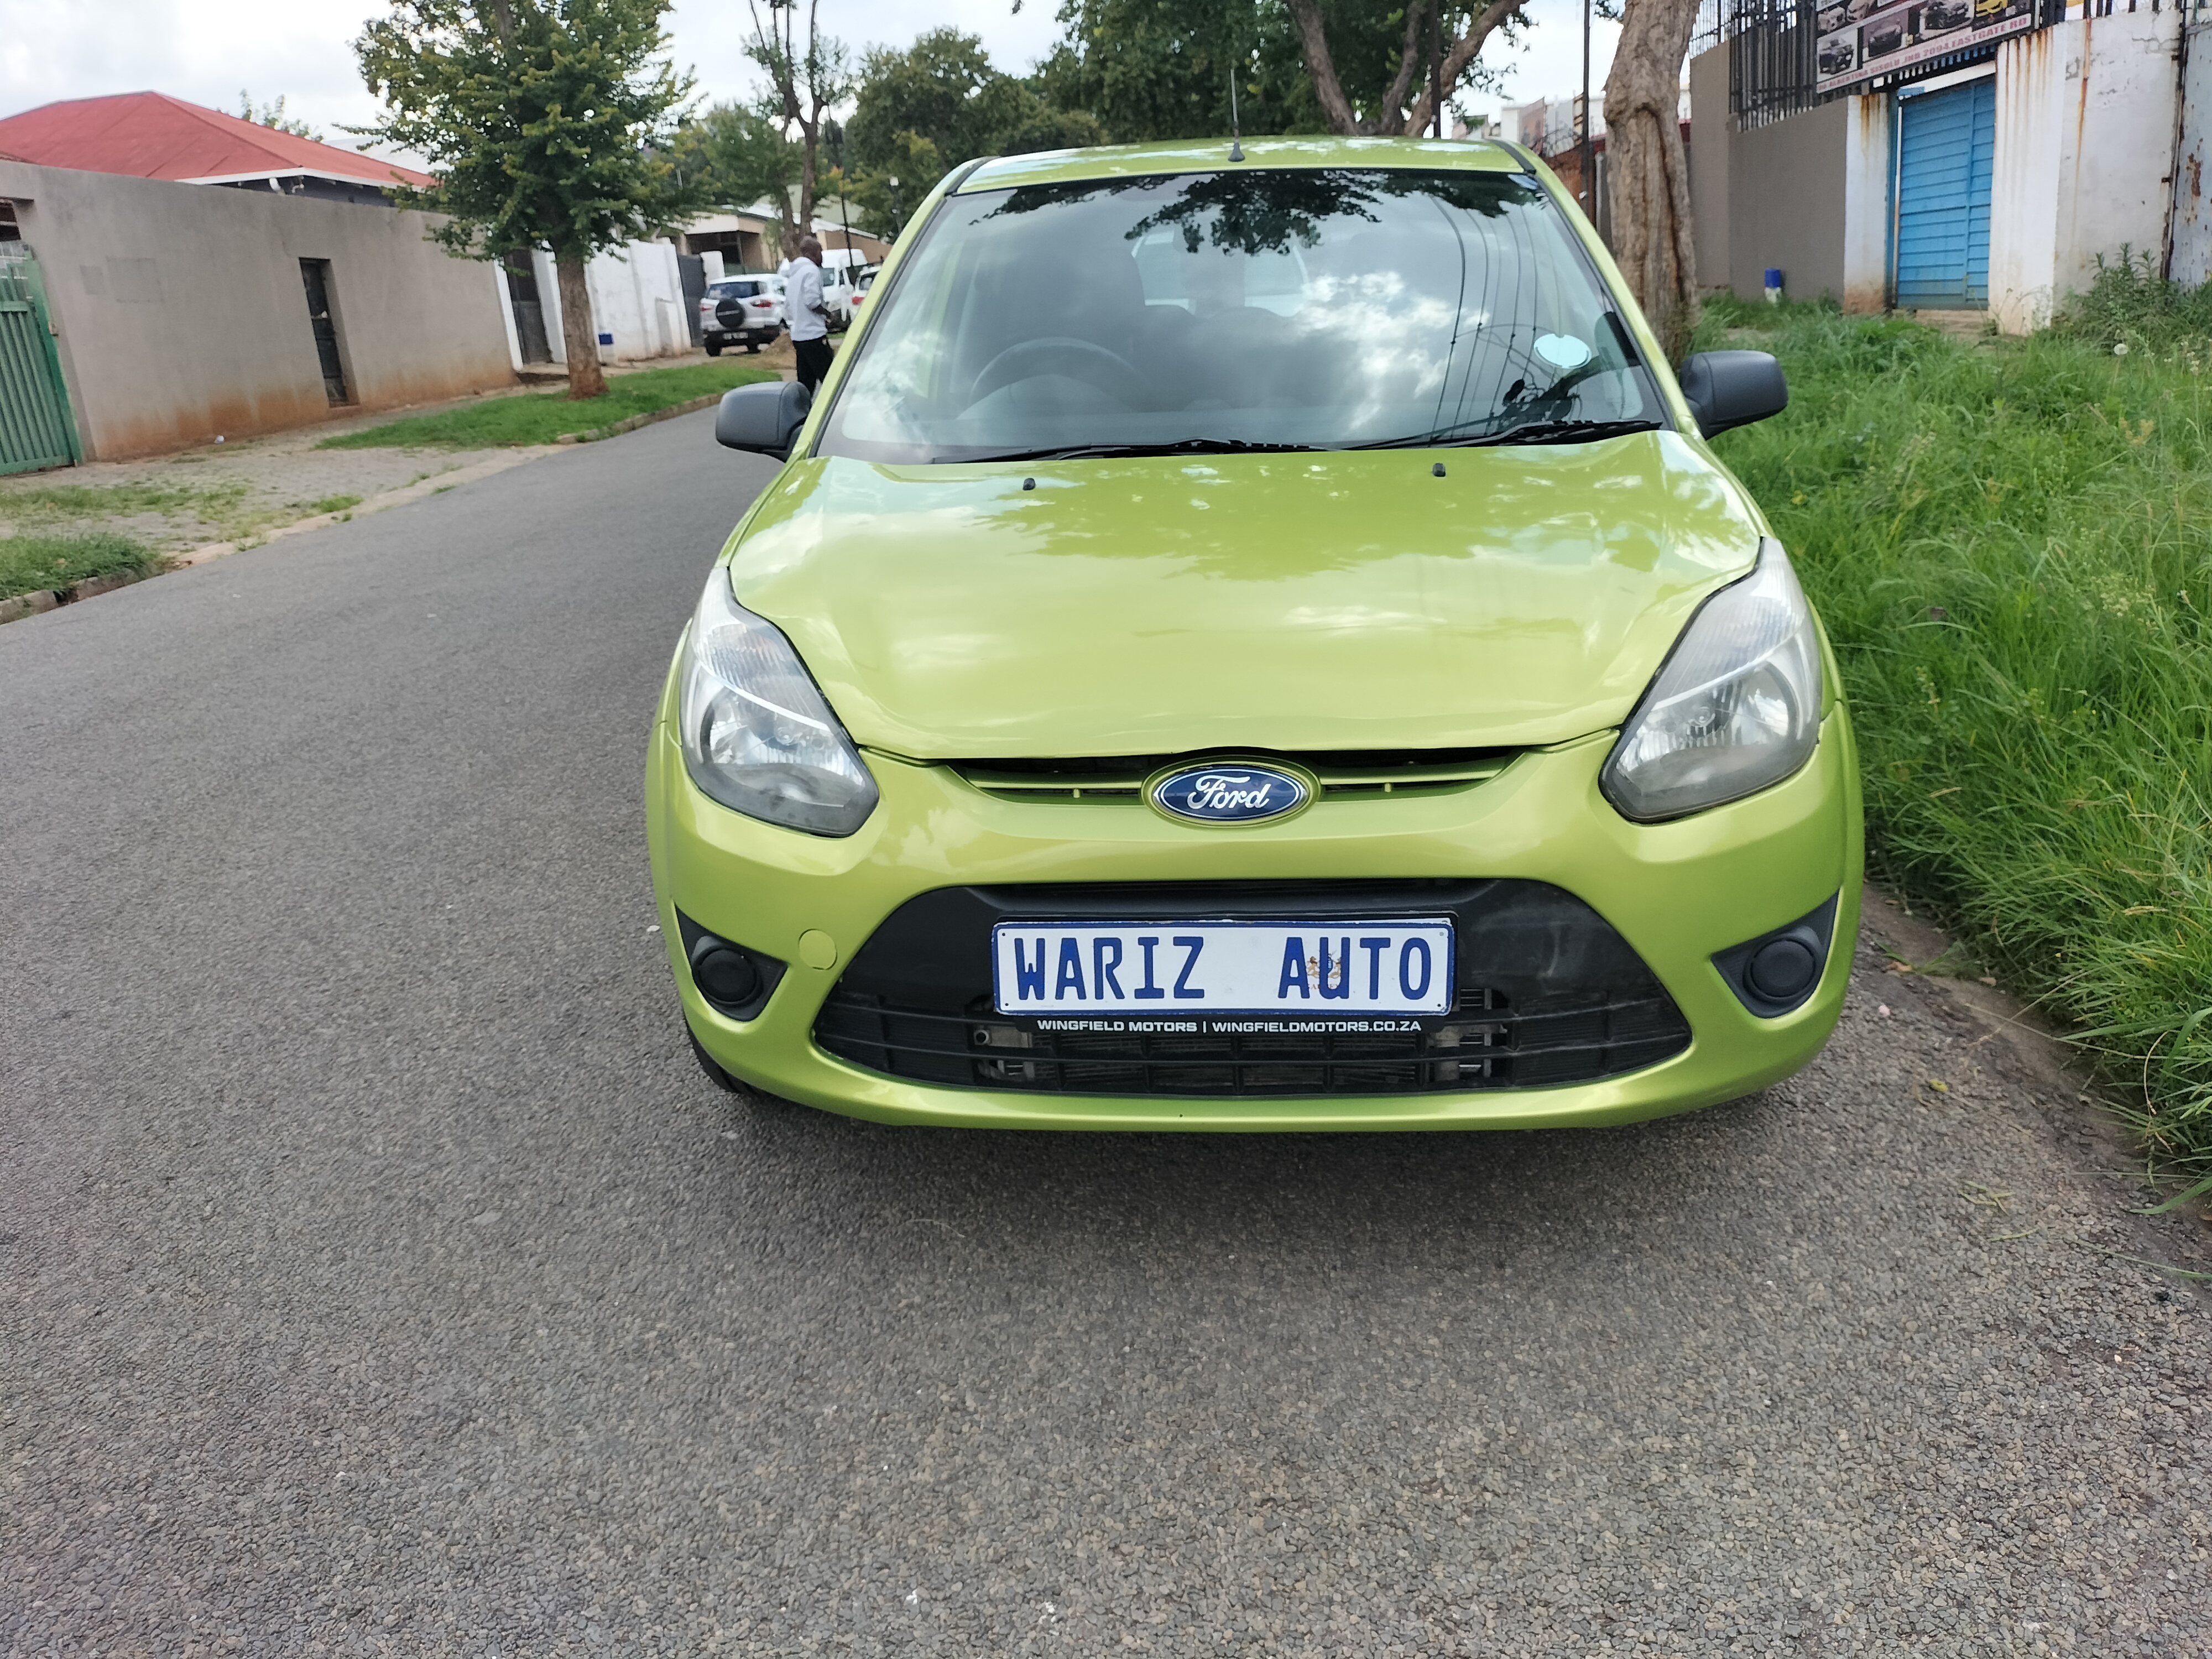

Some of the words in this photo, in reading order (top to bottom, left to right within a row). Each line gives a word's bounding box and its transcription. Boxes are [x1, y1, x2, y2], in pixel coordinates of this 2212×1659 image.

[1952, 24, 2006, 48] EASTGATE
[2010, 17, 2027, 29] RD
[1187, 774, 1272, 810] Ford
[1014, 936, 1206, 1000] WARIZ
[1277, 936, 1432, 1000] AUTO
[1037, 1020, 1125, 1031] WINGFIELD
[1128, 1021, 1198, 1032] MOTORS
[1212, 1020, 1422, 1033] WINGFIELDMOTORS.CO.ZA
